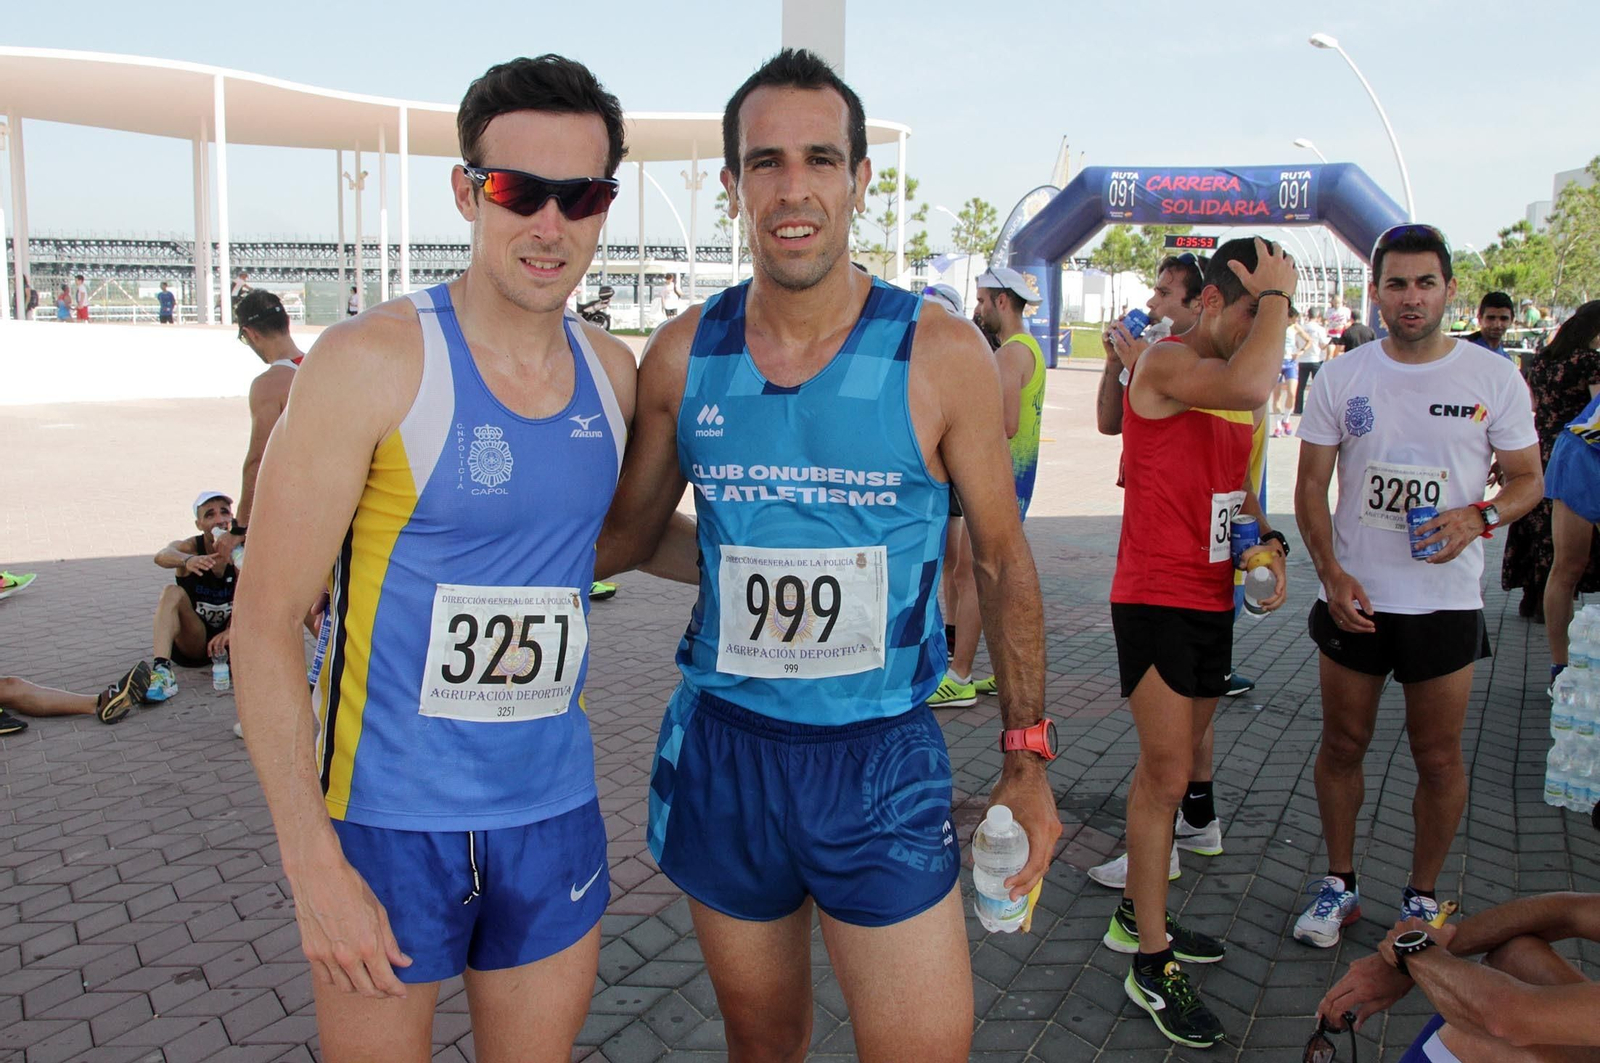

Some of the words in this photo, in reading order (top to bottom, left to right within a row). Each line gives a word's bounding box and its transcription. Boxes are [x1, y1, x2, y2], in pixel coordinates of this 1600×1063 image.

[1111, 172, 1139, 180] RUTA
[1145, 175, 1241, 192] CARRERA
[1281, 171, 1311, 180] RUTA
[1109, 180, 1136, 207] 091
[1279, 181, 1309, 209] 091
[1161, 198, 1270, 216] SOLIDARIA
[1176, 237, 1214, 247] 0:35:53
[1429, 404, 1475, 418] CNP
[695, 428, 724, 438] mobel
[692, 463, 744, 480] CLUB
[748, 464, 903, 486] ONUBENSE
[722, 485, 897, 507] ATLETISMO
[1369, 475, 1440, 513] 3289
[725, 555, 758, 566] DIRECCIÓN
[759, 558, 795, 567] GENERAL
[797, 559, 808, 567] DE
[810, 559, 821, 567] LA
[823, 557, 853, 566] POLICÍA
[442, 595, 487, 605] DIRECCIÓN
[488, 597, 522, 605] GENERAL
[524, 597, 534, 605] DE
[535, 597, 546, 605] LA
[746, 573, 842, 643] 999
[441, 613, 569, 685] 3251
[726, 643, 796, 659] AGRUPACIÓN
[800, 644, 868, 659] DEPORTIVA
[784, 664, 799, 673] 999
[430, 687, 513, 701] AGRUPACIÓN
[516, 685, 572, 700] DEPORTIVA
[497, 706, 515, 717] 3251
[888, 841, 929, 872] DE
